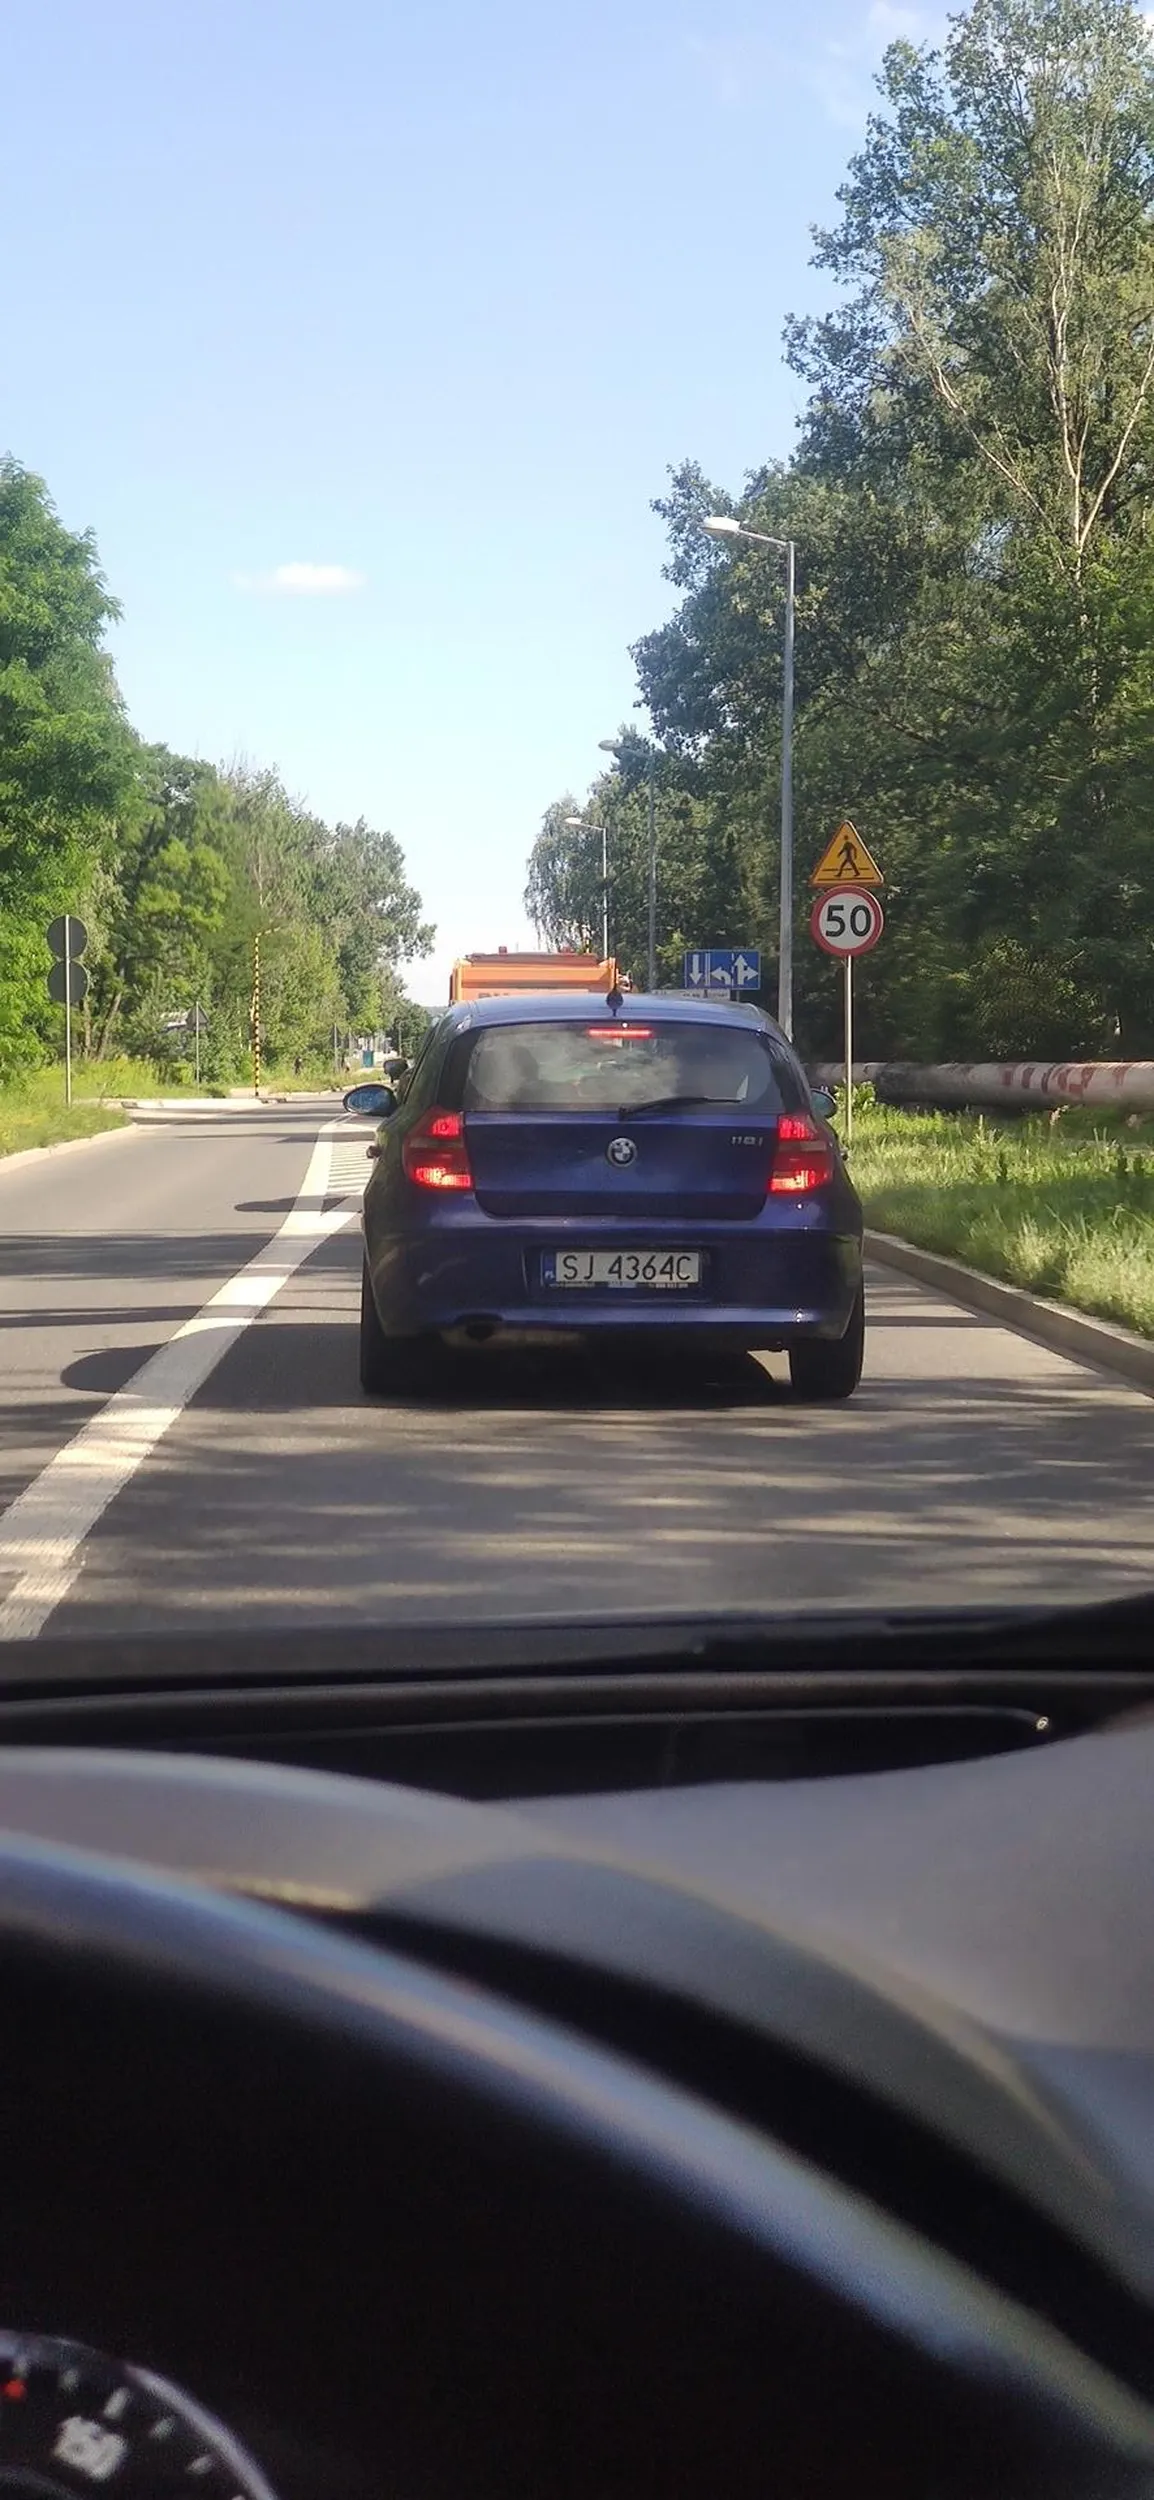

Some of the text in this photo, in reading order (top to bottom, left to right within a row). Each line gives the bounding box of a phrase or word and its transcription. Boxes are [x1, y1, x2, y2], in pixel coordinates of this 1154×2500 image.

[825, 904, 872, 937] 50
[562, 1254, 692, 1281] SJ 4364C
